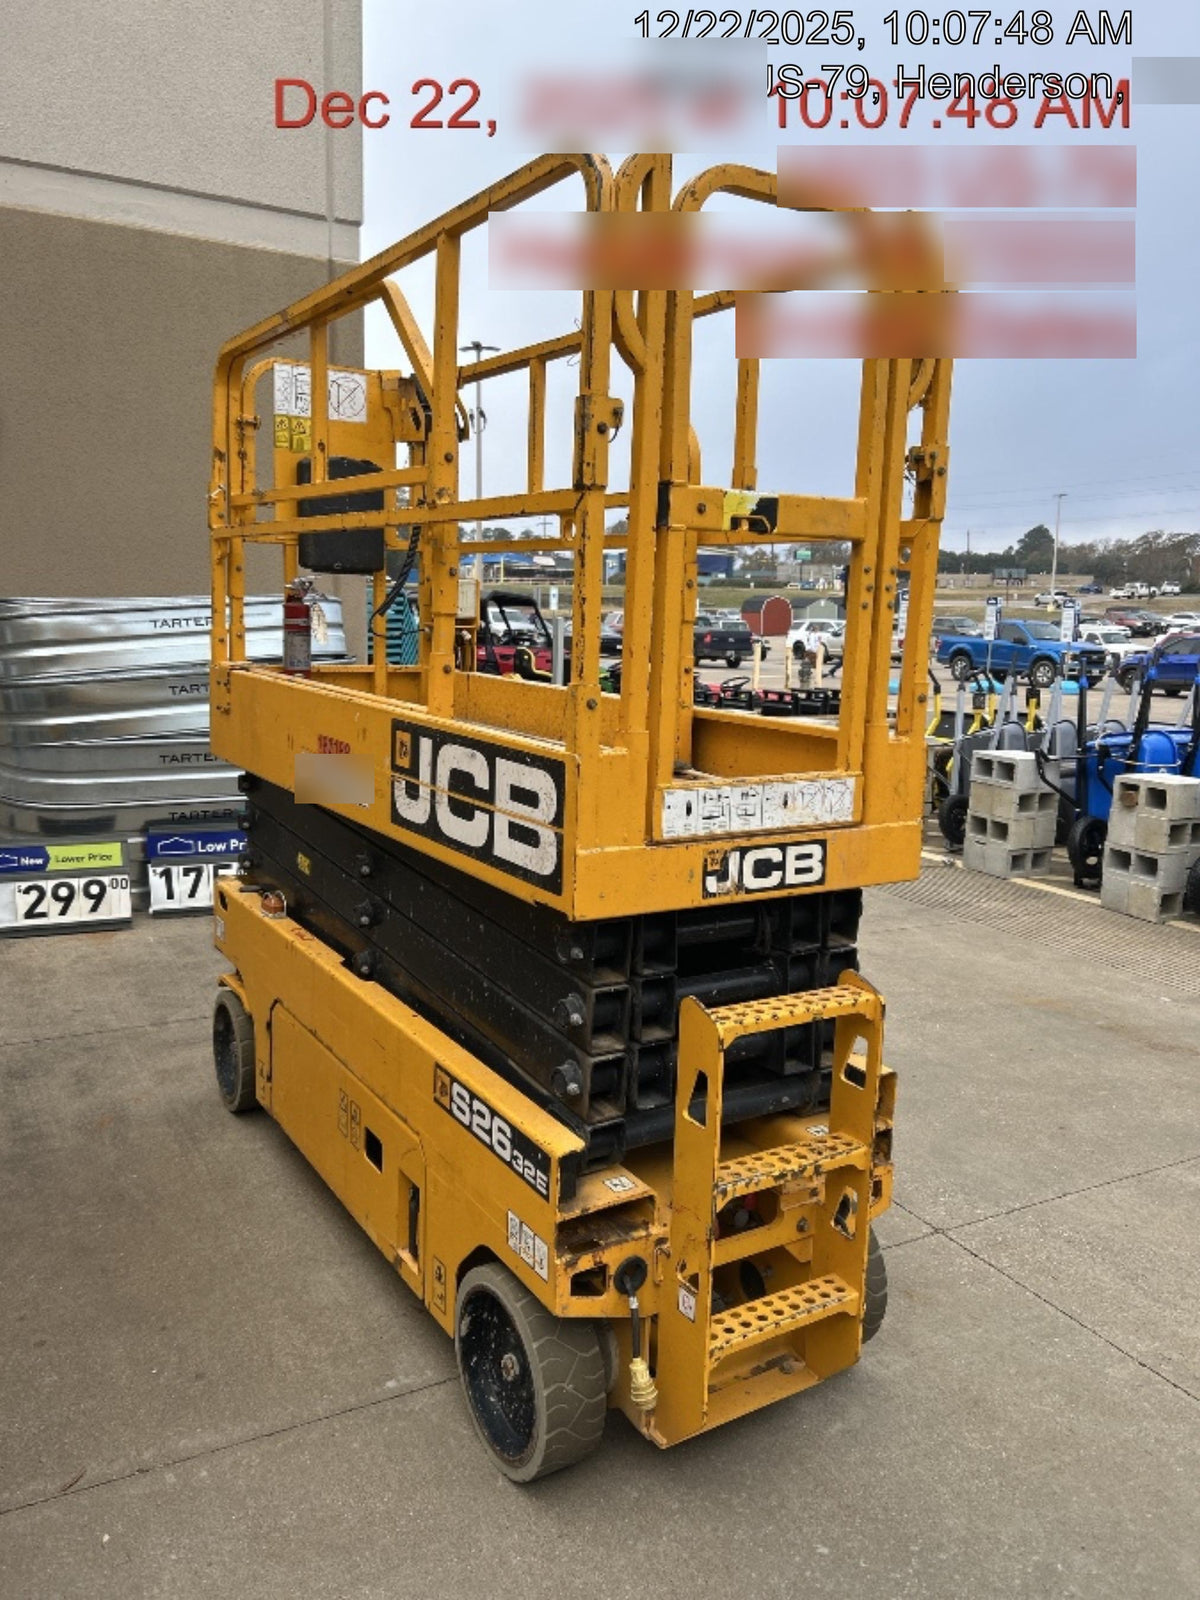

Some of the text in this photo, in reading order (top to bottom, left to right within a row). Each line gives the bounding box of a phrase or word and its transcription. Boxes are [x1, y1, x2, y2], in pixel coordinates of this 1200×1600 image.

[168, 683, 210, 696] TART
[394, 735, 558, 876] JCB
[198, 838, 248, 852] Low Pr
[21, 853, 113, 866] New Lower Price
[705, 843, 823, 893] JCB
